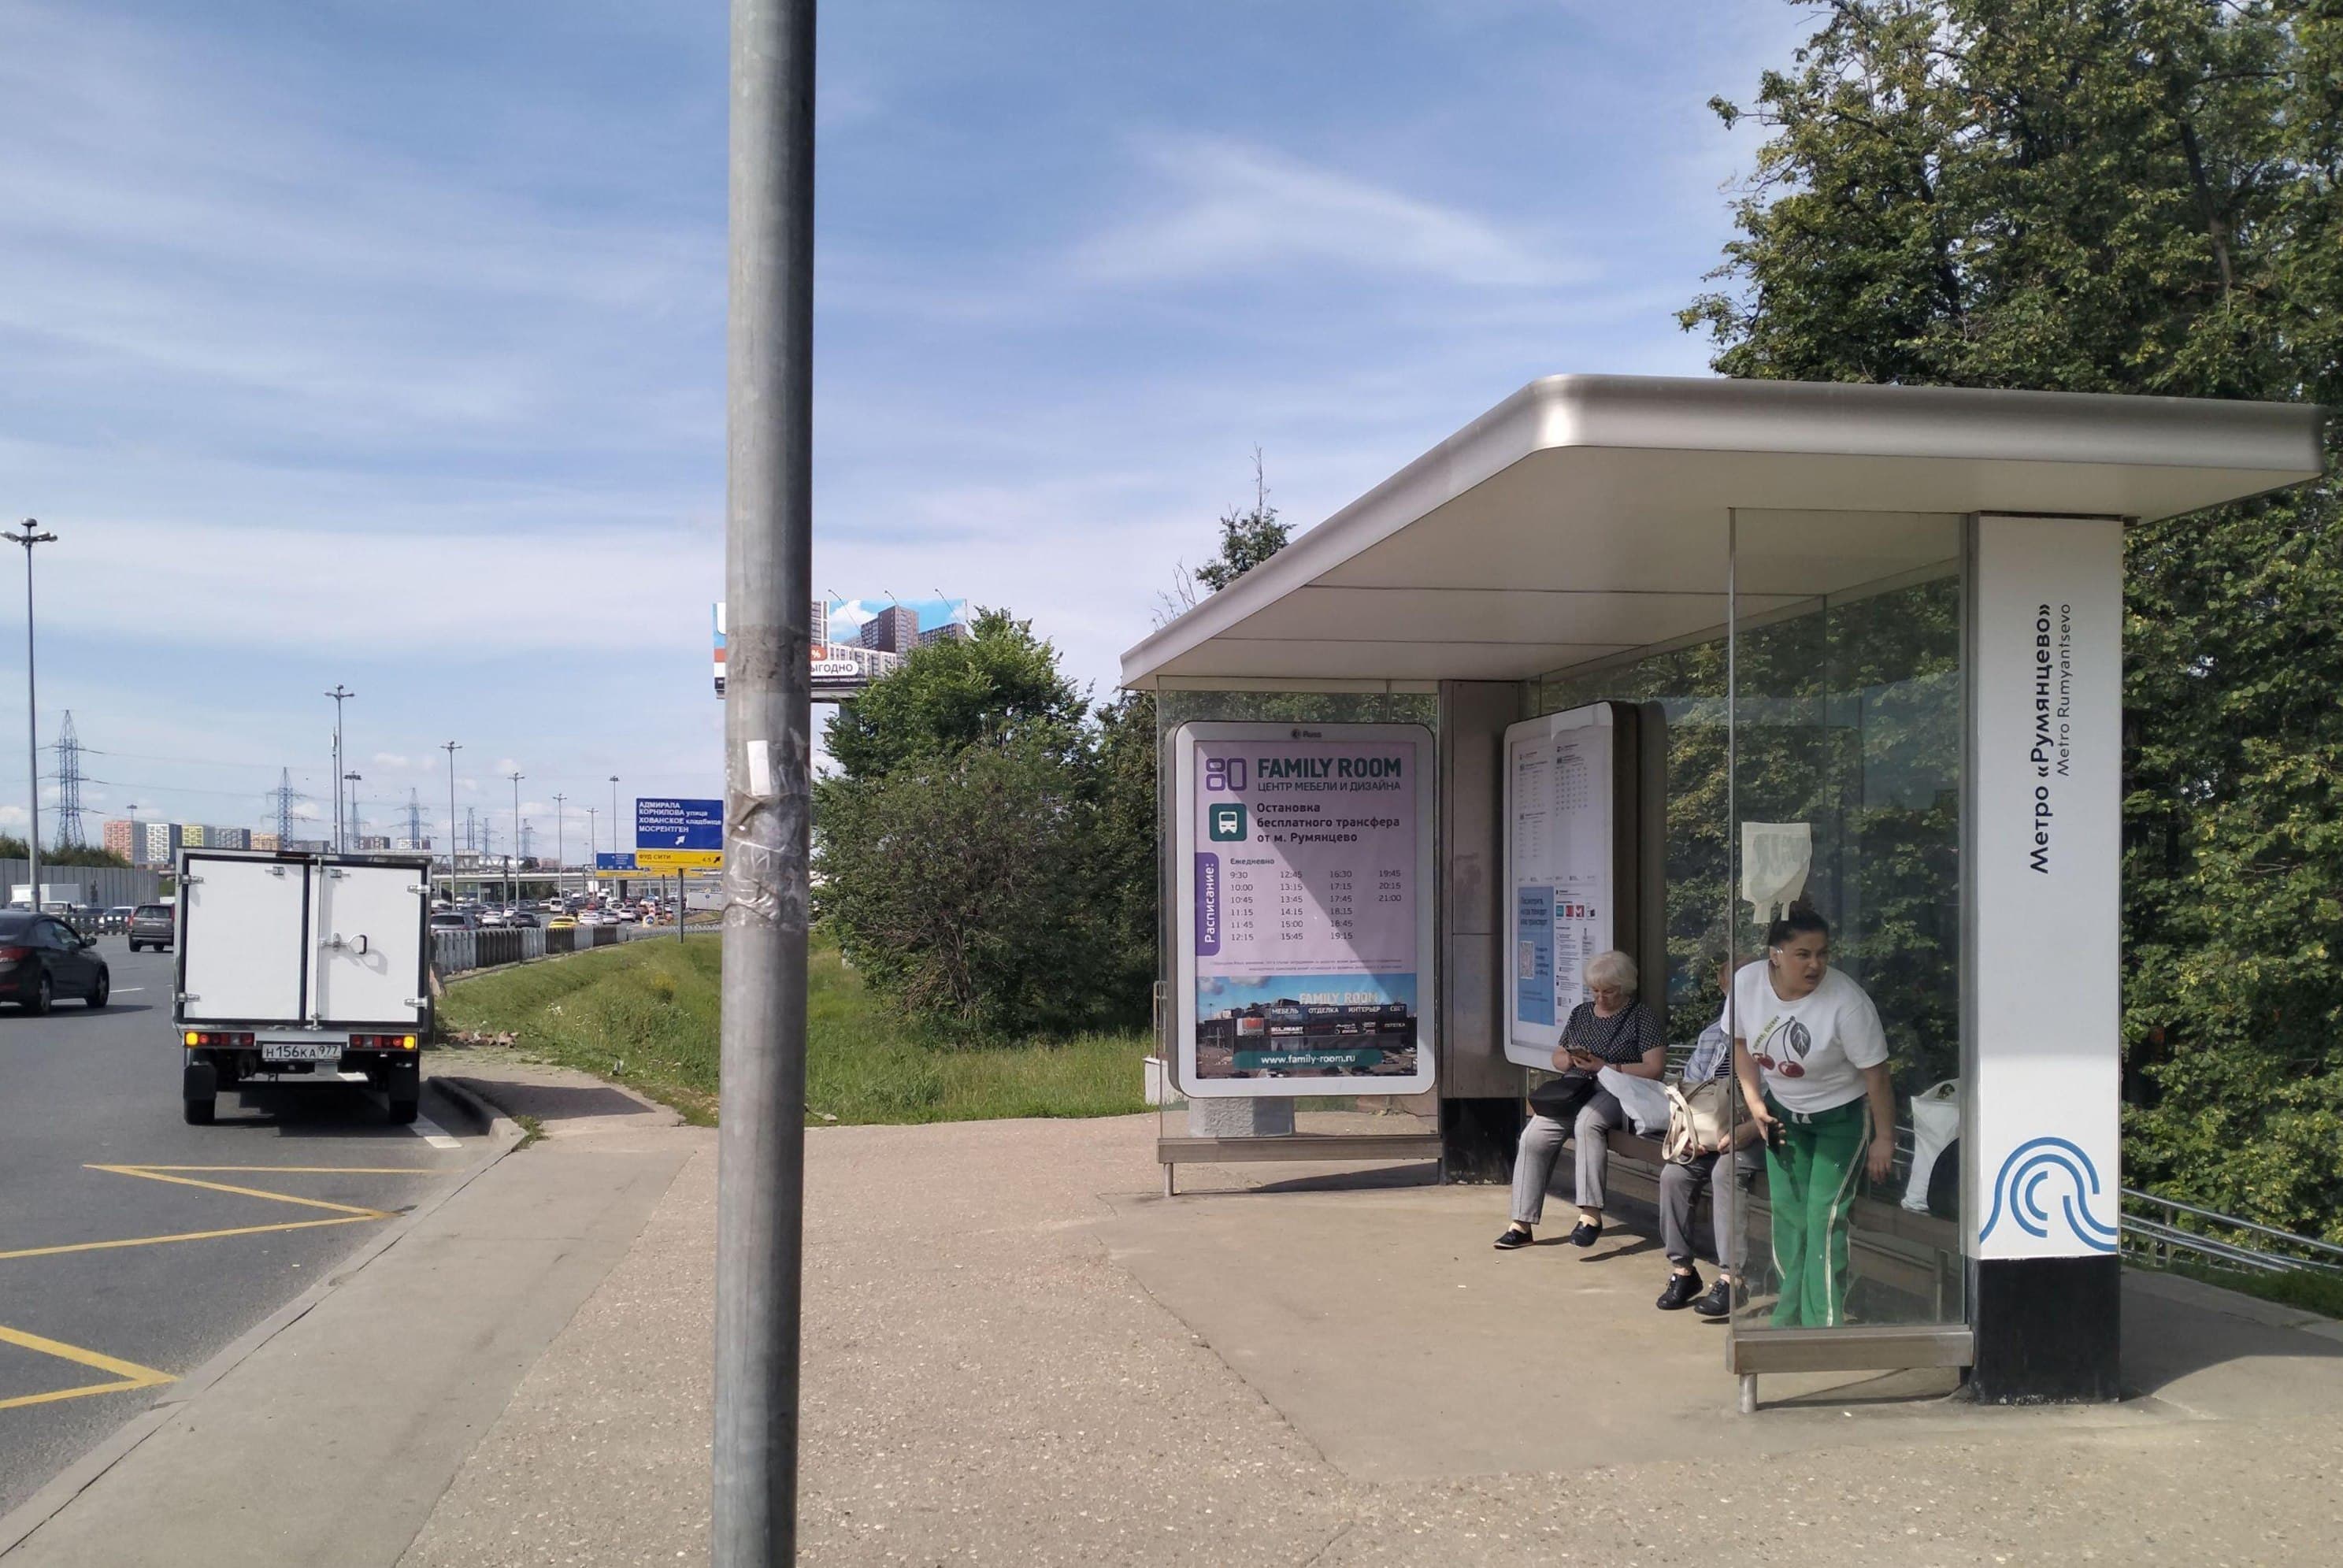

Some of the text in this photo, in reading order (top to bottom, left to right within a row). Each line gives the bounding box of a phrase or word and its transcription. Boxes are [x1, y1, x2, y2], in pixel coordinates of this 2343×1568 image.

[2057, 603, 2074, 777] Metro Rumyantsevo
[2030, 603, 2054, 874] Метро «Румянцево»
[1258, 758, 1402, 778] FAMILY ROOM
[1258, 780, 1401, 793] ЦЕНТР МЕБЕЛИ И ДИЗАЙНА
[1257, 803, 1321, 813] Остановка
[1257, 817, 1400, 829] бесплатного трансфера
[1273, 834, 1287, 843] м.
[1290, 832, 1358, 844] Румянцево
[1204, 863, 1216, 943] Расписание:
[1299, 992, 1378, 1005] FAMILY ROOM
[265, 1045, 338, 1058] Н156КА 977
[1260, 1054, 1356, 1064] www.family-room.ru
